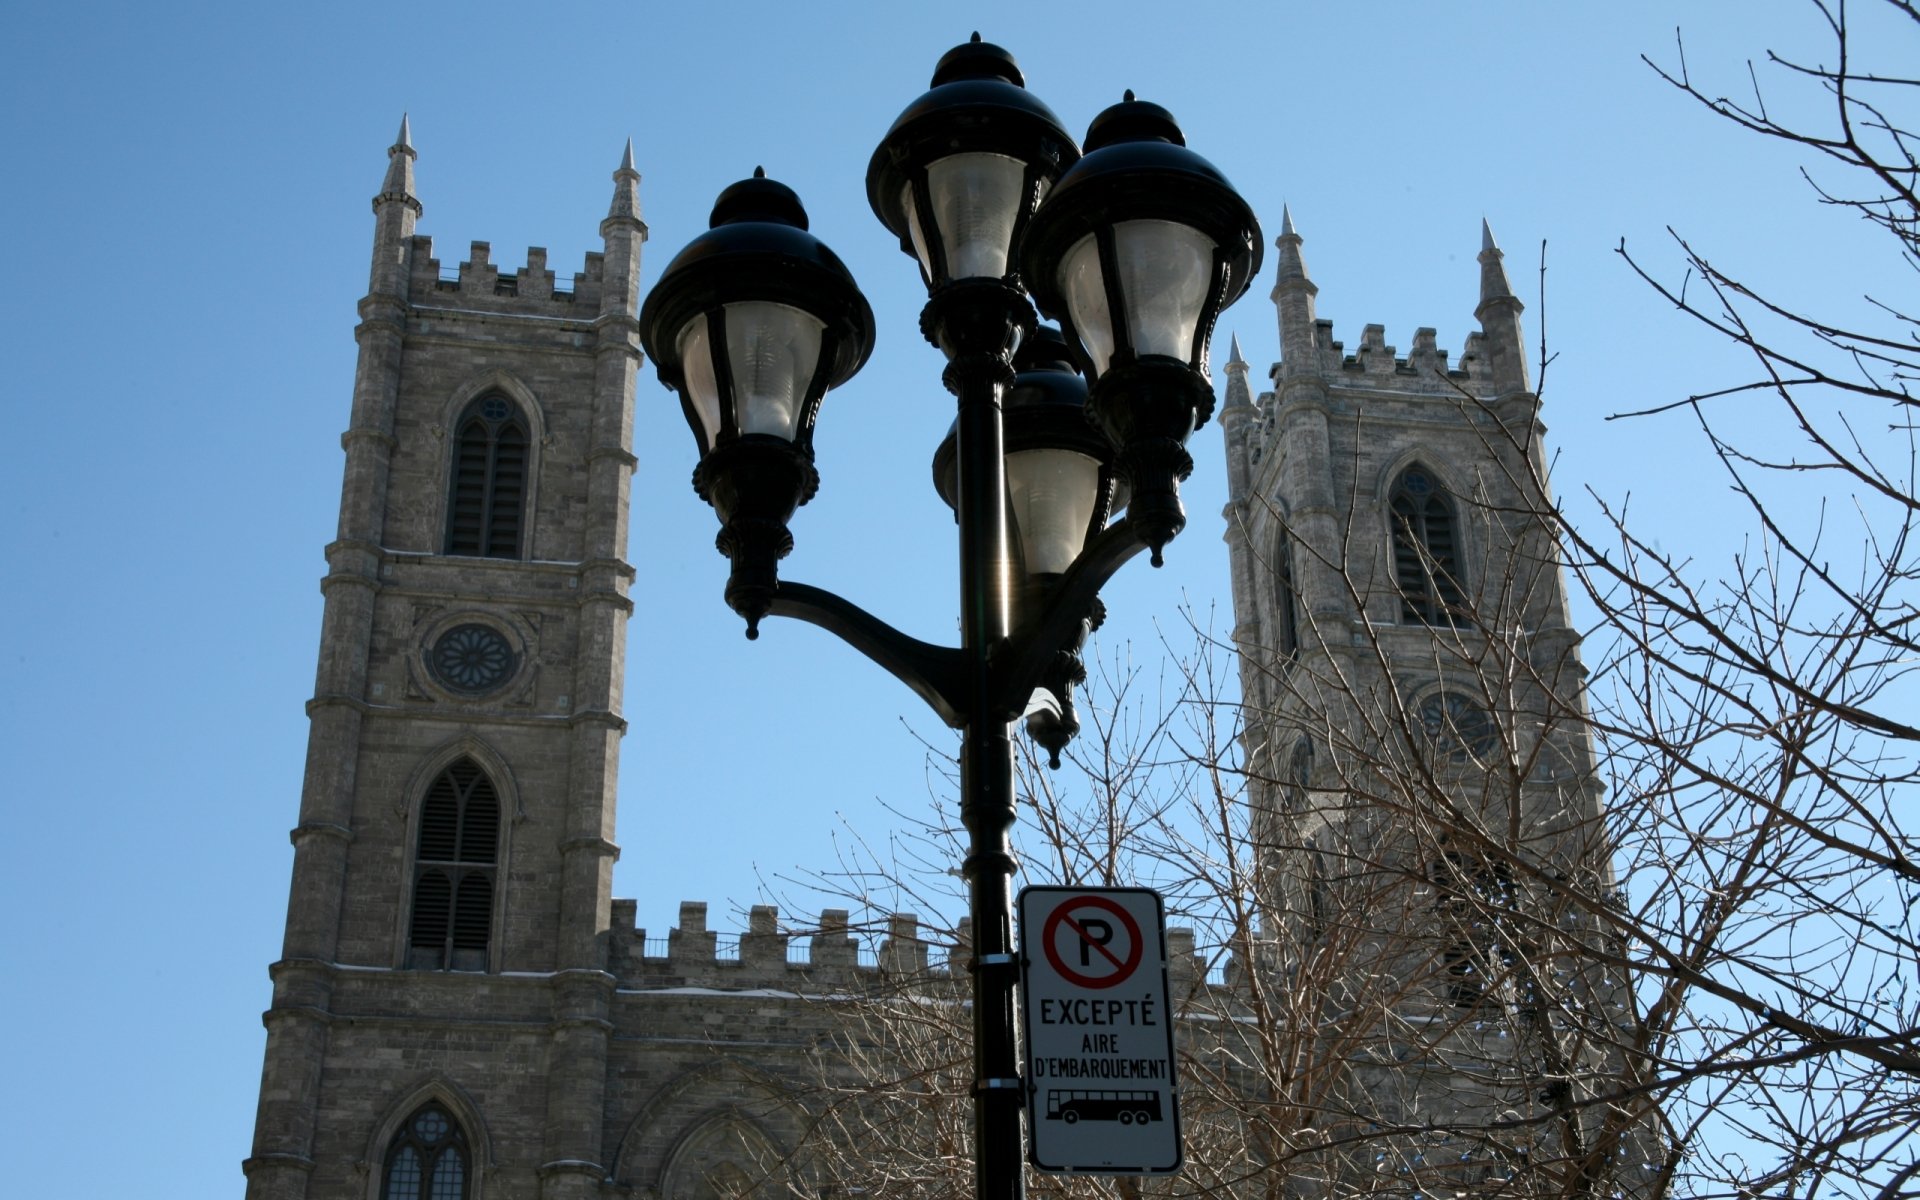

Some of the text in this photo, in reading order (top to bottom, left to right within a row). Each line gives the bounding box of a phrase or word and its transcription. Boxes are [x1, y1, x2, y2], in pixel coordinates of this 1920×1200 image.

[1078, 919, 1113, 966] P
[1041, 994, 1157, 1026] EXCEPTÉ
[1082, 1034, 1119, 1054] AIRE
[1035, 1058, 1166, 1080] D'EMBARQUEMENT
